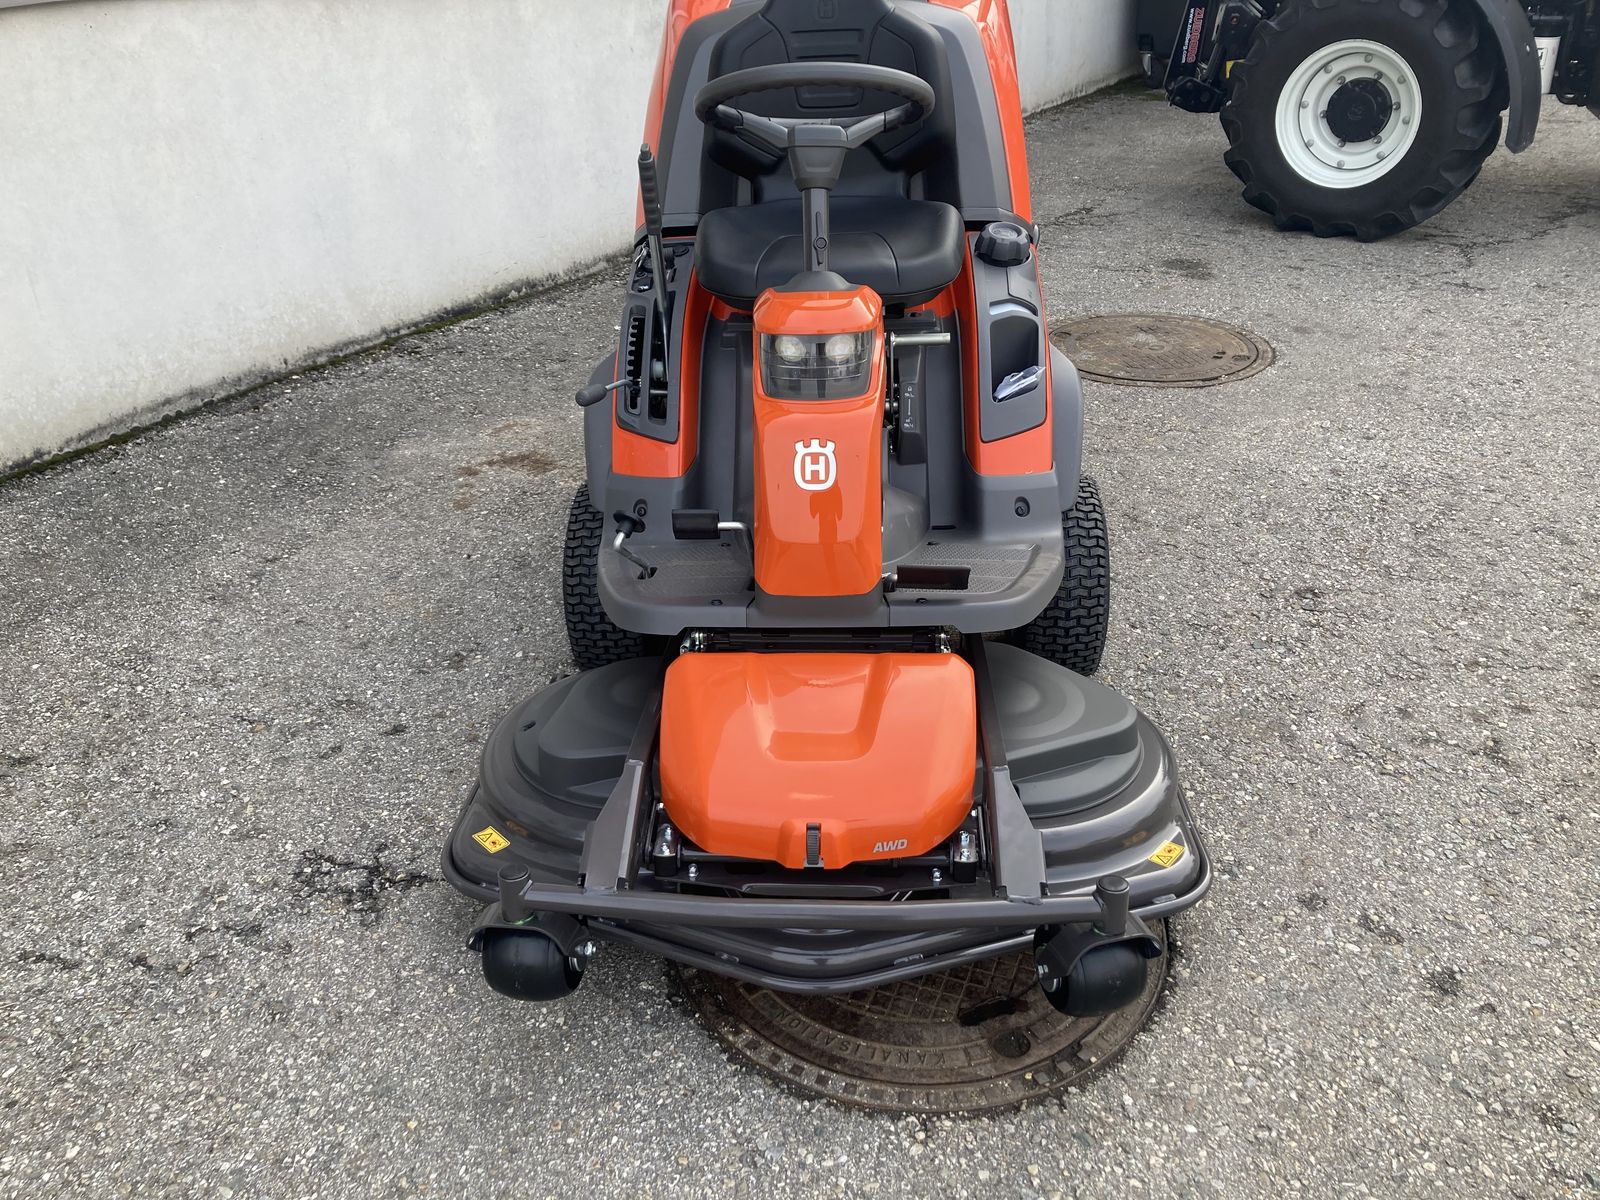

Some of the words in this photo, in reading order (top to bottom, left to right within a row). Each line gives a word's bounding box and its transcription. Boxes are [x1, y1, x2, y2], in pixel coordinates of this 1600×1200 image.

[1181, 7, 1194, 64] www.zuidberg.com
[1186, 7, 1205, 64] ZUIDBERG
[873, 838, 908, 853] AWD
[775, 1009, 946, 1065] KANALISATION
